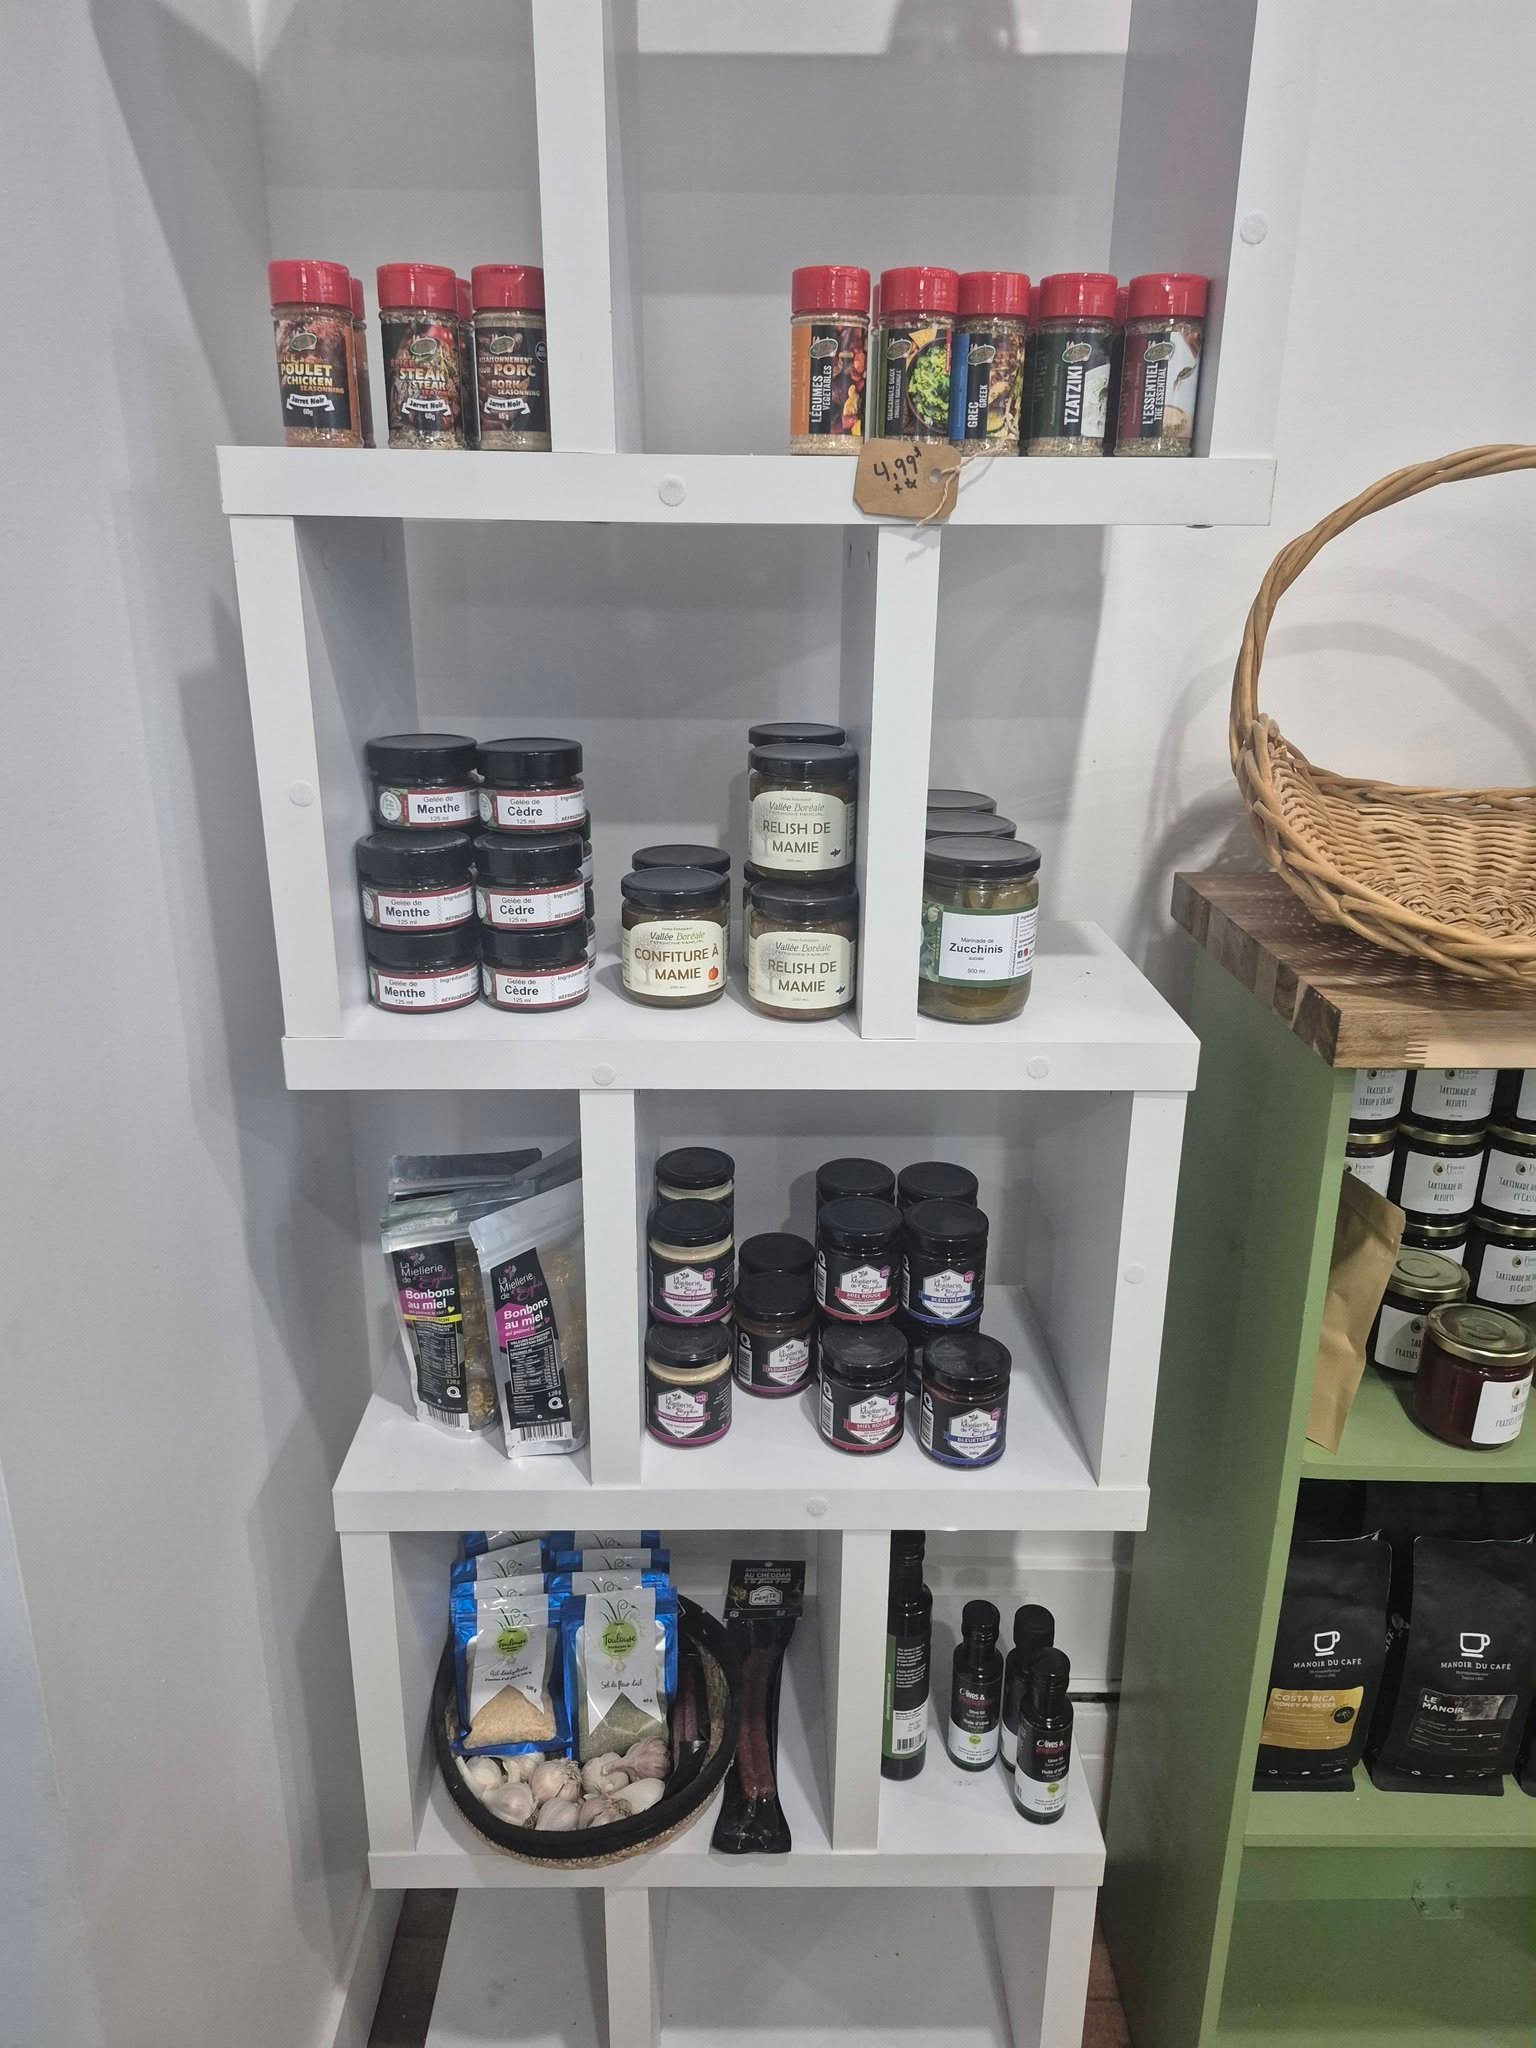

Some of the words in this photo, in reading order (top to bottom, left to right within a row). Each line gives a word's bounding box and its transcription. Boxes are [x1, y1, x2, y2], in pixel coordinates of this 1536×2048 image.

[281, 363, 332, 377] POULET
[399, 367, 446, 381] STEAK
[494, 363, 536, 377] PORC
[491, 379, 520, 389] PORK
[822, 365, 832, 411] VEGETABLES
[1156, 367, 1167, 406] ESSENTIAL
[809, 375, 823, 423] LÉGUMES
[979, 384, 988, 409] GREEK
[1064, 365, 1083, 425] TZATZIKI
[1142, 362, 1159, 425] L'ESSENTIEL
[291, 396, 309, 405] Jarret
[310, 396, 325, 405] Noir
[409, 401, 429, 409] Jarret
[489, 399, 505, 408] Jarret
[967, 401, 979, 428] GREC
[1154, 404, 1163, 421] THE
[417, 803, 460, 814] Menthe
[507, 806, 543, 817] Cèdre
[769, 801, 792, 812] Vallée
[794, 804, 825, 812] Boréale
[763, 820, 808, 835] RELISH
[813, 822, 831, 834] DE
[772, 840, 819, 853] MAMIE
[385, 906, 430, 917] Menthe
[500, 905, 535, 915] Cèdre
[650, 931, 674, 941] Vallée
[676, 931, 705, 941] Boréale
[634, 947, 709, 962] CONFITURE
[712, 943, 719, 957] À
[775, 941, 799, 951] Vallée
[801, 943, 831, 953] Boréale
[949, 942, 1003, 954] Zucchinis
[768, 959, 815, 974] RELISH
[820, 961, 837, 974] DE
[655, 967, 701, 980] MAMIE
[388, 979, 407, 987] Gelée
[778, 979, 826, 993] MAMIE
[384, 985, 426, 998] Menthe
[504, 985, 539, 996] Cèdre
[1427, 1180, 1456, 1190] TARTINADE
[400, 1261, 410, 1269] La
[401, 1264, 444, 1276] Miellerie
[498, 1276, 508, 1285] La
[499, 1272, 533, 1293] Miellerie
[405, 1287, 455, 1299] Bonbons
[500, 1292, 511, 1300] de
[407, 1301, 420, 1309] au
[422, 1298, 447, 1310] miel
[504, 1297, 548, 1320] Bonbons
[504, 1320, 519, 1330] au
[522, 1310, 544, 1326] miel
[602, 1633, 636, 1646] Toulouse
[1293, 1660, 1326, 1669] MANOIR
[1340, 1657, 1362, 1666] CAFÉ
[1440, 1661, 1472, 1669] MANOIR
[1475, 1662, 1488, 1670] DU
[959, 1687, 979, 1700] Olives
[1275, 1694, 1310, 1702] COSTA
[1424, 1694, 1438, 1704] LE
[1422, 1702, 1464, 1714] MANOIR
[1036, 1739, 1058, 1748] Olives
